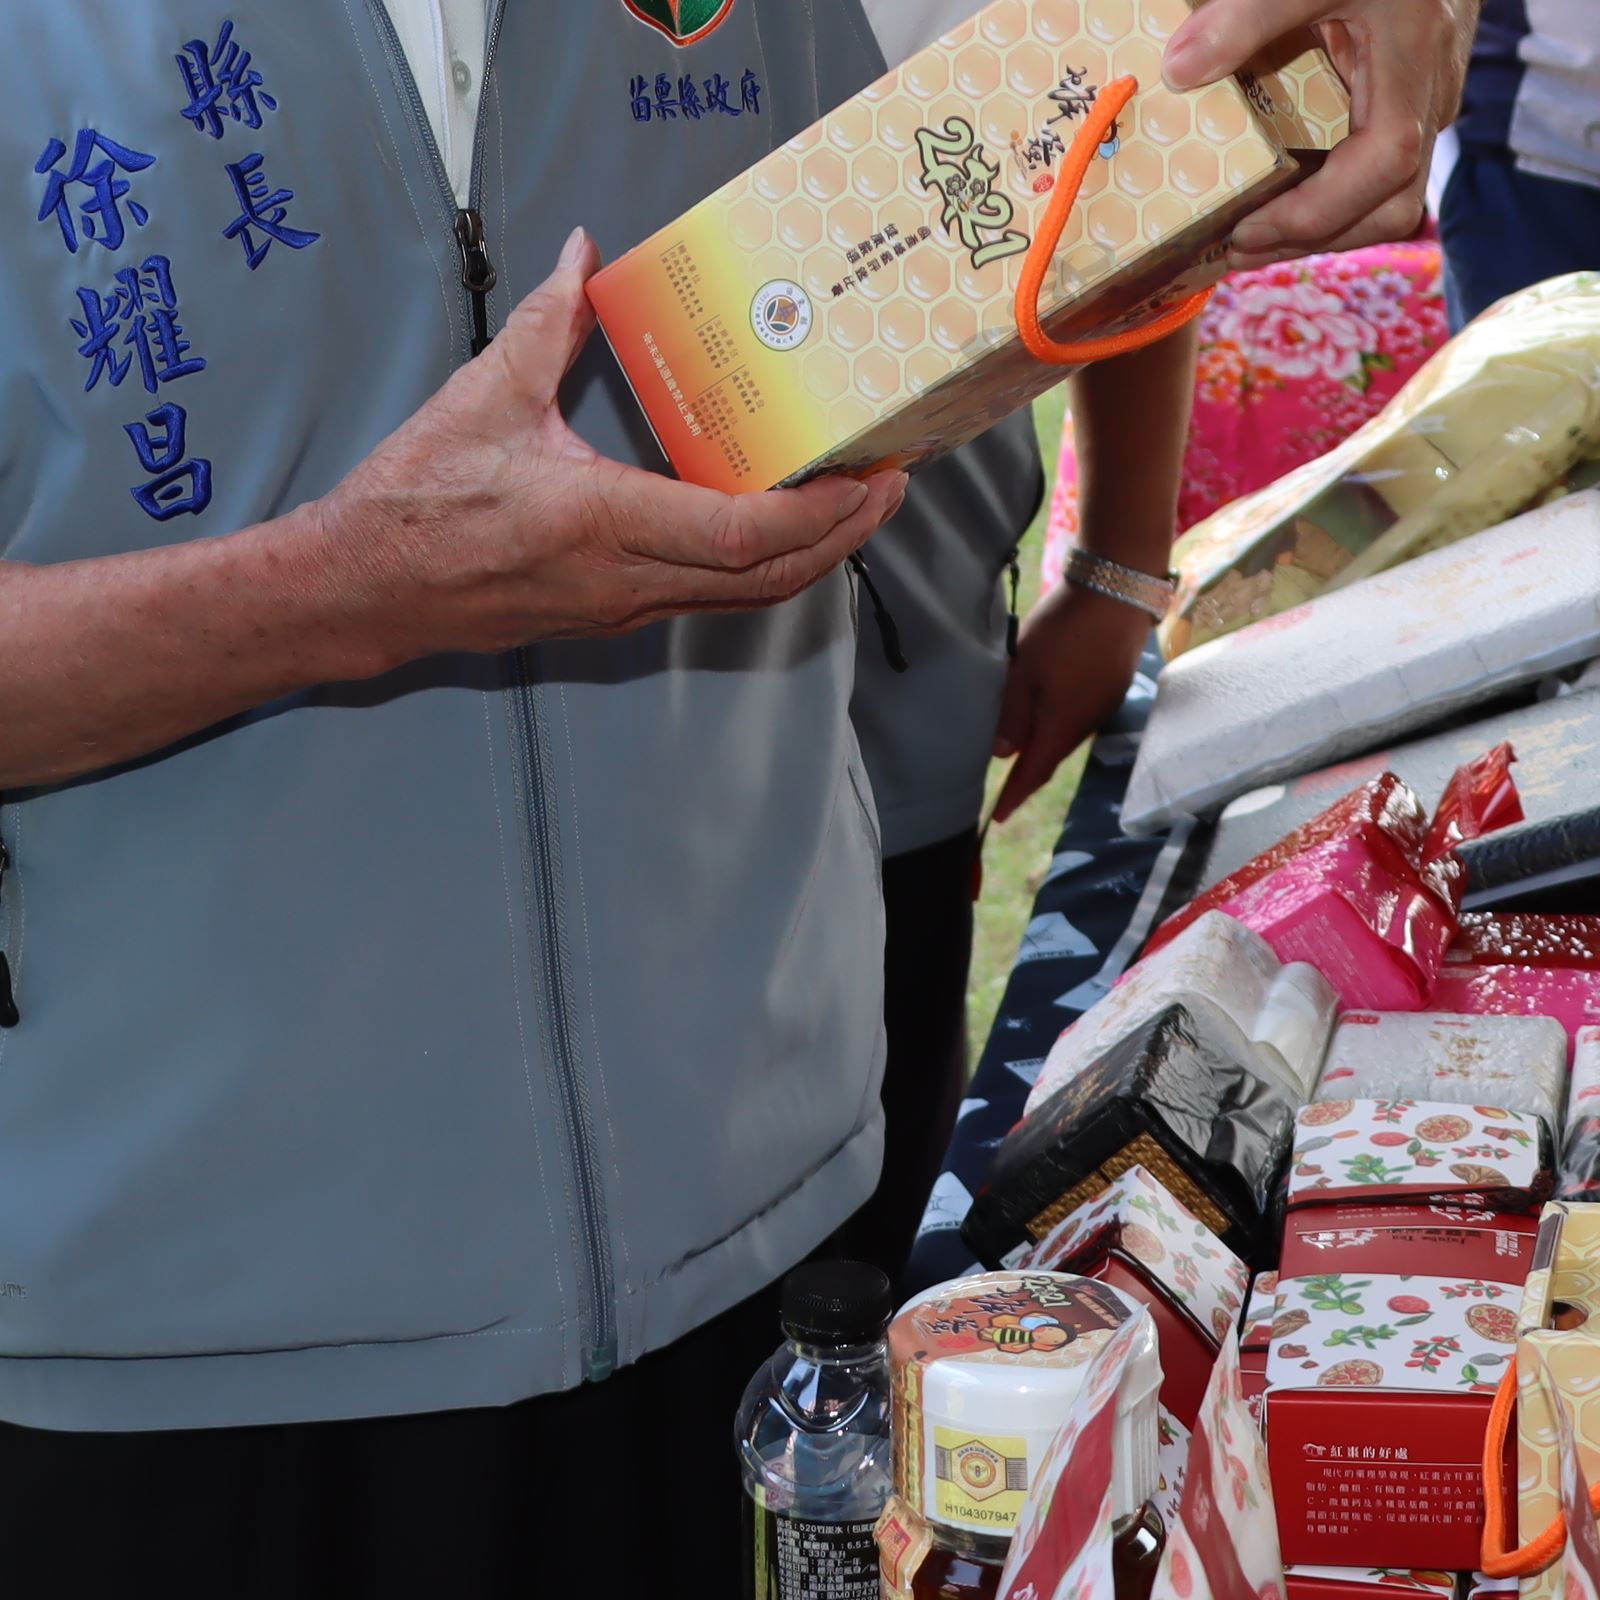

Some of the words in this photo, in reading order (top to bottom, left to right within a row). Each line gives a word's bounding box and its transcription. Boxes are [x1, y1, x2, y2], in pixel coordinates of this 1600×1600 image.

[630, 68, 760, 122] 苗栗縣政府
[175, 19, 321, 271] 縣長
[34, 127, 214, 521] 徐耀昌
[1330, 1444, 1408, 1460] 紅棗的好處
[945, 1503, 1017, 1523] H104307947
